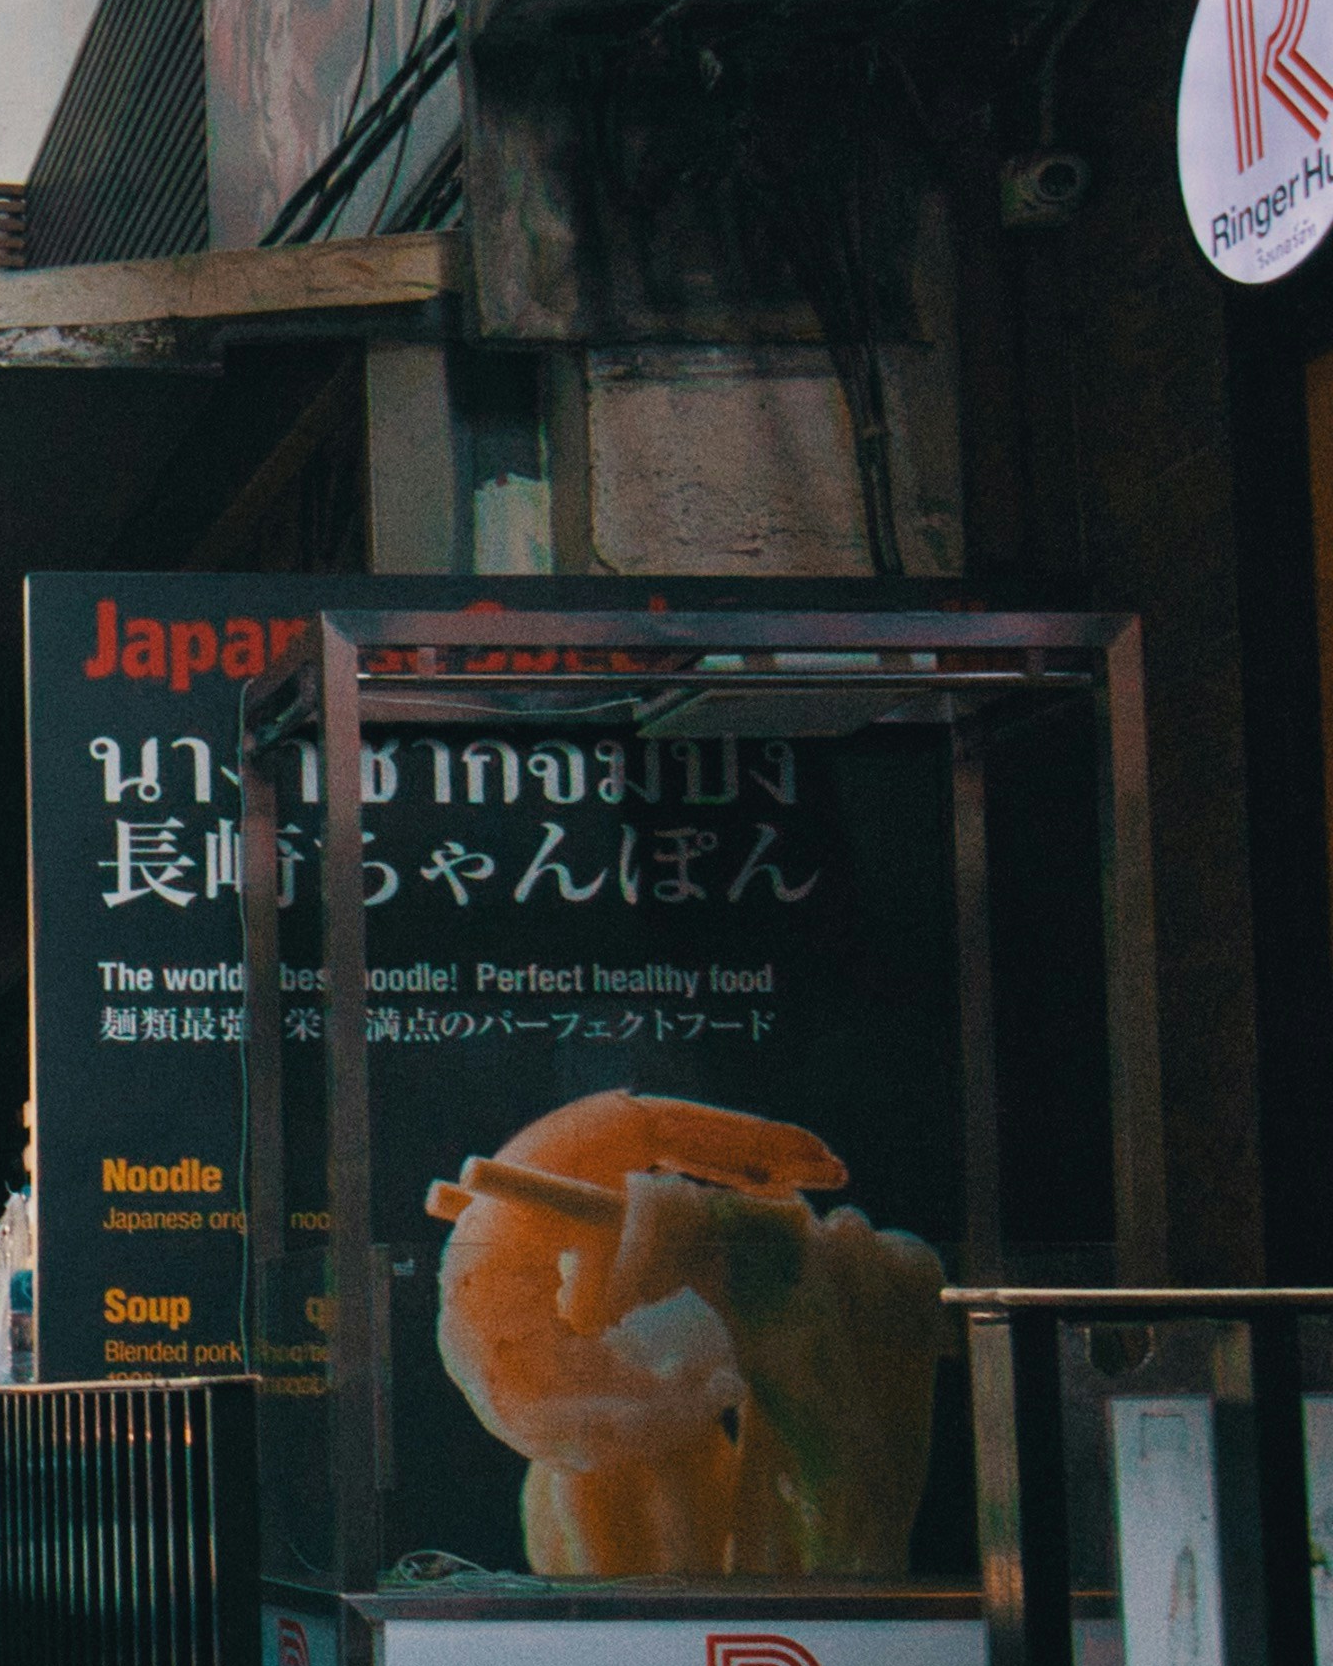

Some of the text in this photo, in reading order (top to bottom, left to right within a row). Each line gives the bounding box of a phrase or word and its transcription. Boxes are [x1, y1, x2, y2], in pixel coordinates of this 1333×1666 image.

[1212, 147, 1333, 259] Ringer Hu
[98, 961, 155, 993] The
[279, 961, 331, 993] bes
[364, 961, 459, 993] oodle!
[476, 962, 584, 993] Perfect
[592, 962, 699, 1000] healthy
[710, 962, 774, 994] food
[101, 1157, 224, 1194] Noodle
[102, 1207, 204, 1234] Japanese
[102, 1286, 192, 1331] Soup
[103, 1339, 188, 1363] Blended
[194, 1340, 243, 1365] pork
